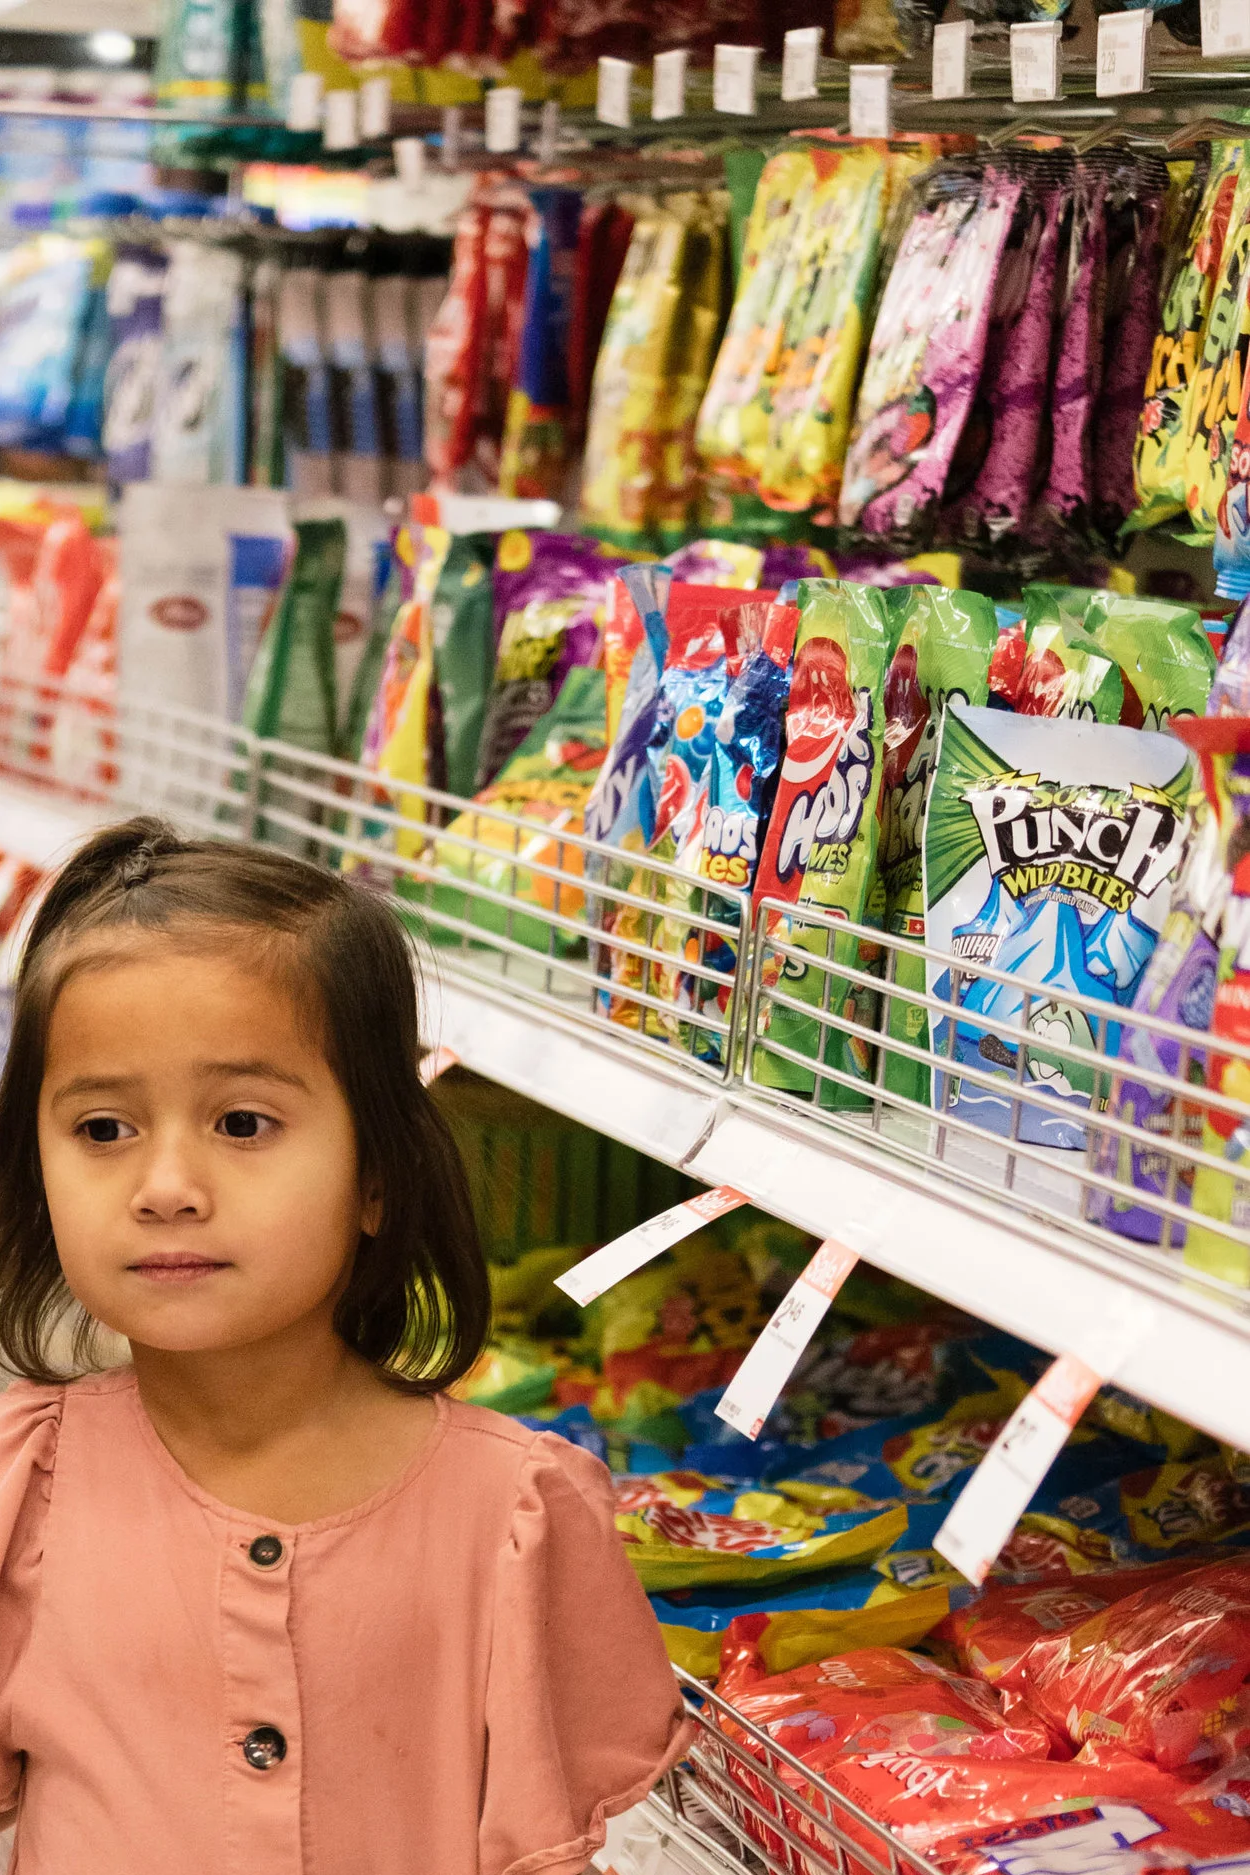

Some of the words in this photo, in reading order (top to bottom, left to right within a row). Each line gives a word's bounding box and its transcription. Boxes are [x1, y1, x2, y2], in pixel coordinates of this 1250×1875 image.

[1000, 862, 1062, 900] WILD
[1061, 861, 1137, 914] BITES
[1046, 891, 1077, 907] FLAVORED
[1076, 898, 1099, 917] CANDY
